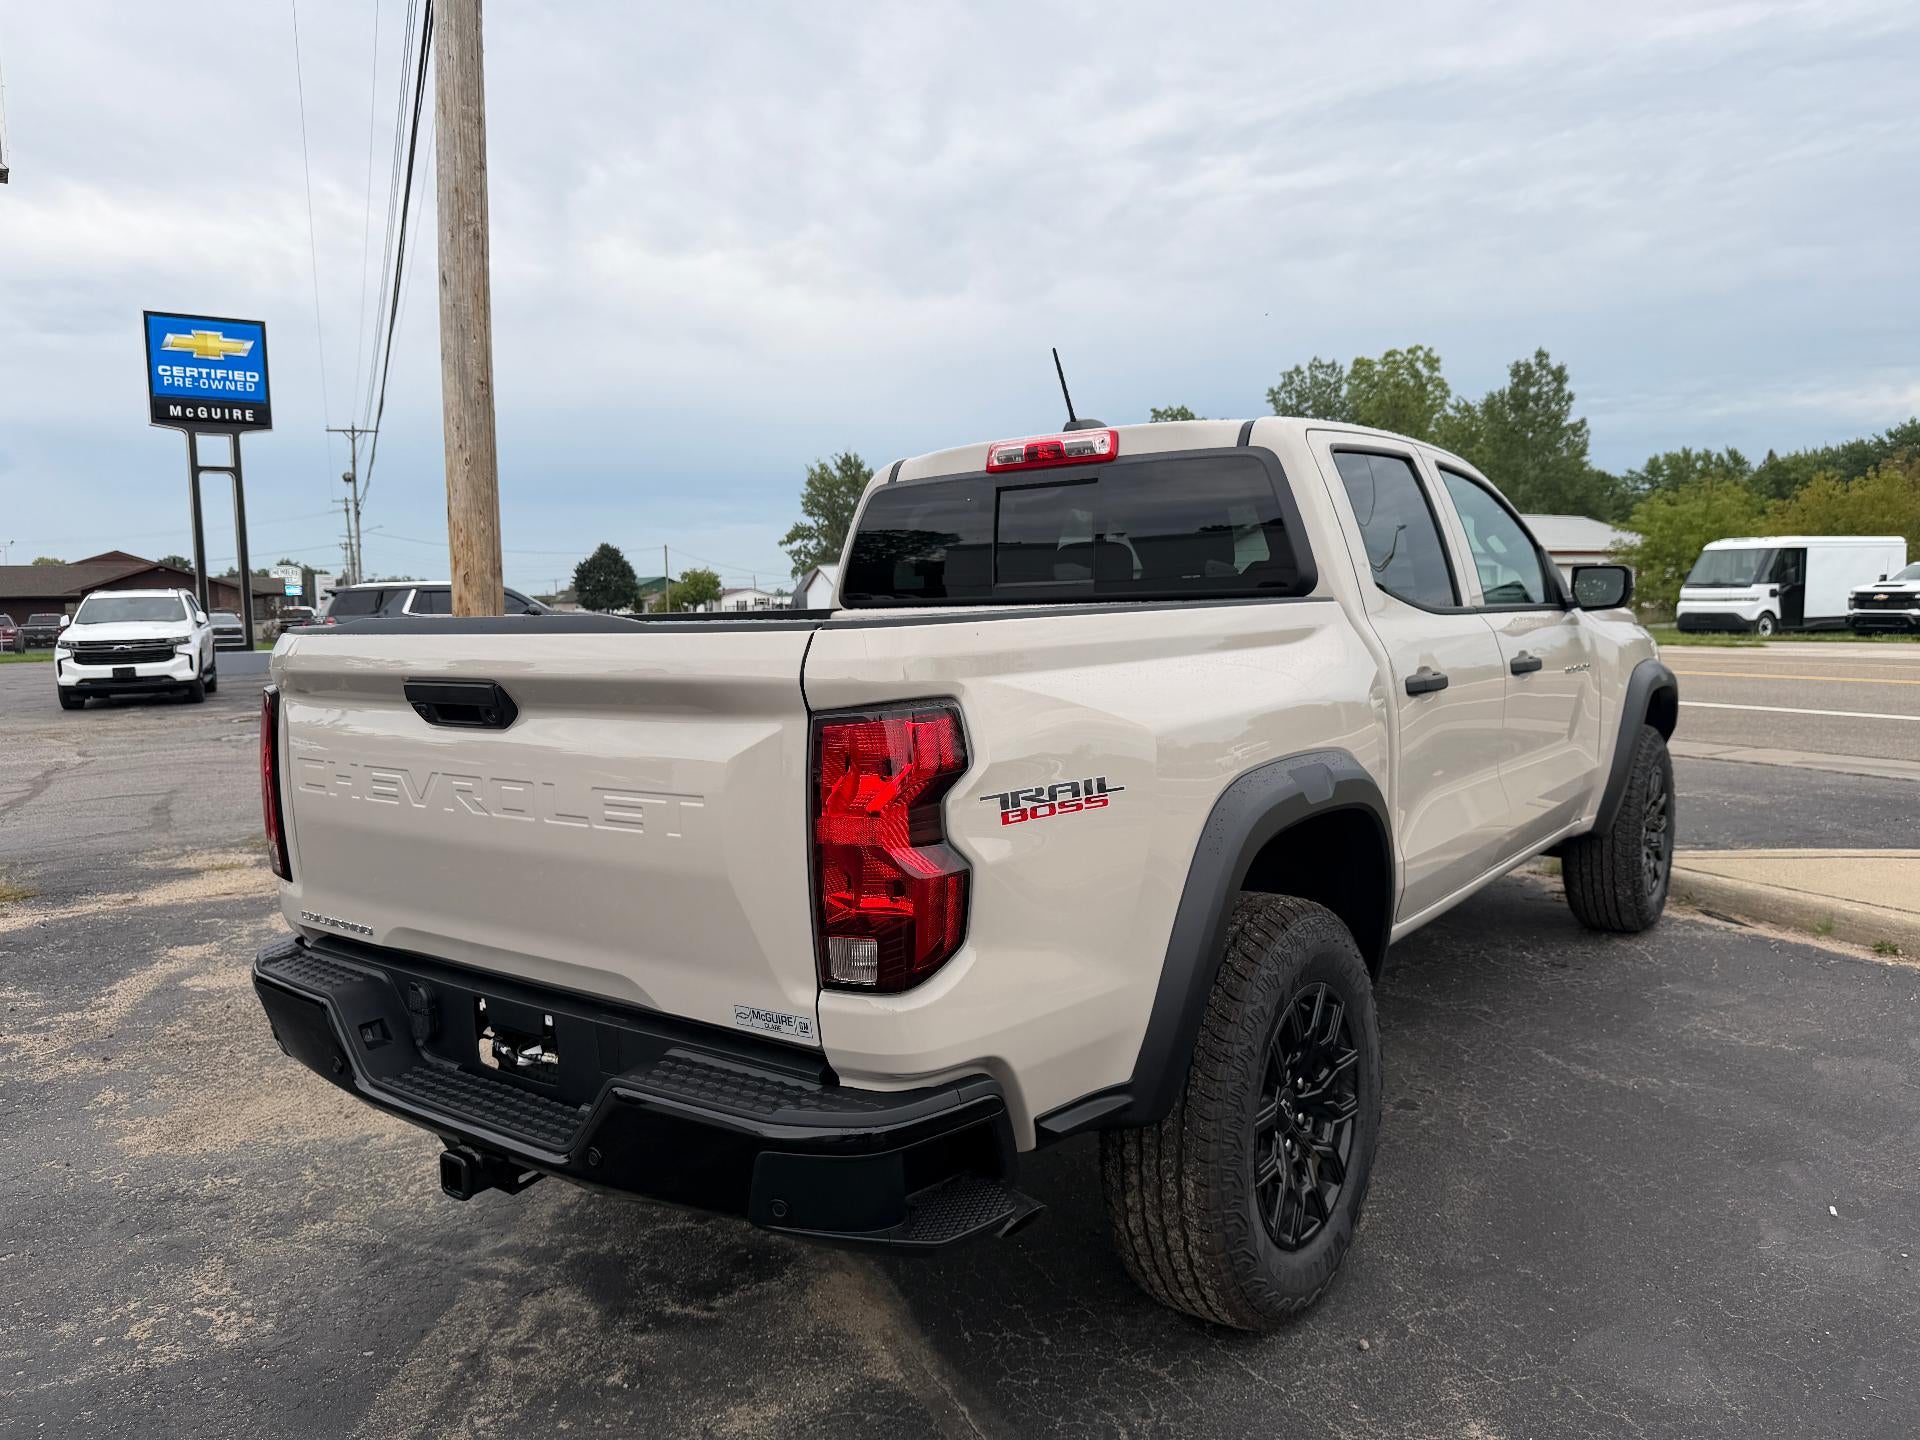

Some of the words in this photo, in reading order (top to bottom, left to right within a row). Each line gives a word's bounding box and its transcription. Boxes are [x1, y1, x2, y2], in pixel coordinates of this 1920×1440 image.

[157, 365, 260, 383] CERTIFIED
[163, 376, 256, 392] PRE-OWNED
[169, 404, 255, 422] McGUIRE
[297, 756, 705, 838] CHEVROLET
[979, 776, 1125, 811] TRAIL
[1000, 793, 1109, 826] BOSS
[751, 1009, 794, 1027] McGUIRE
